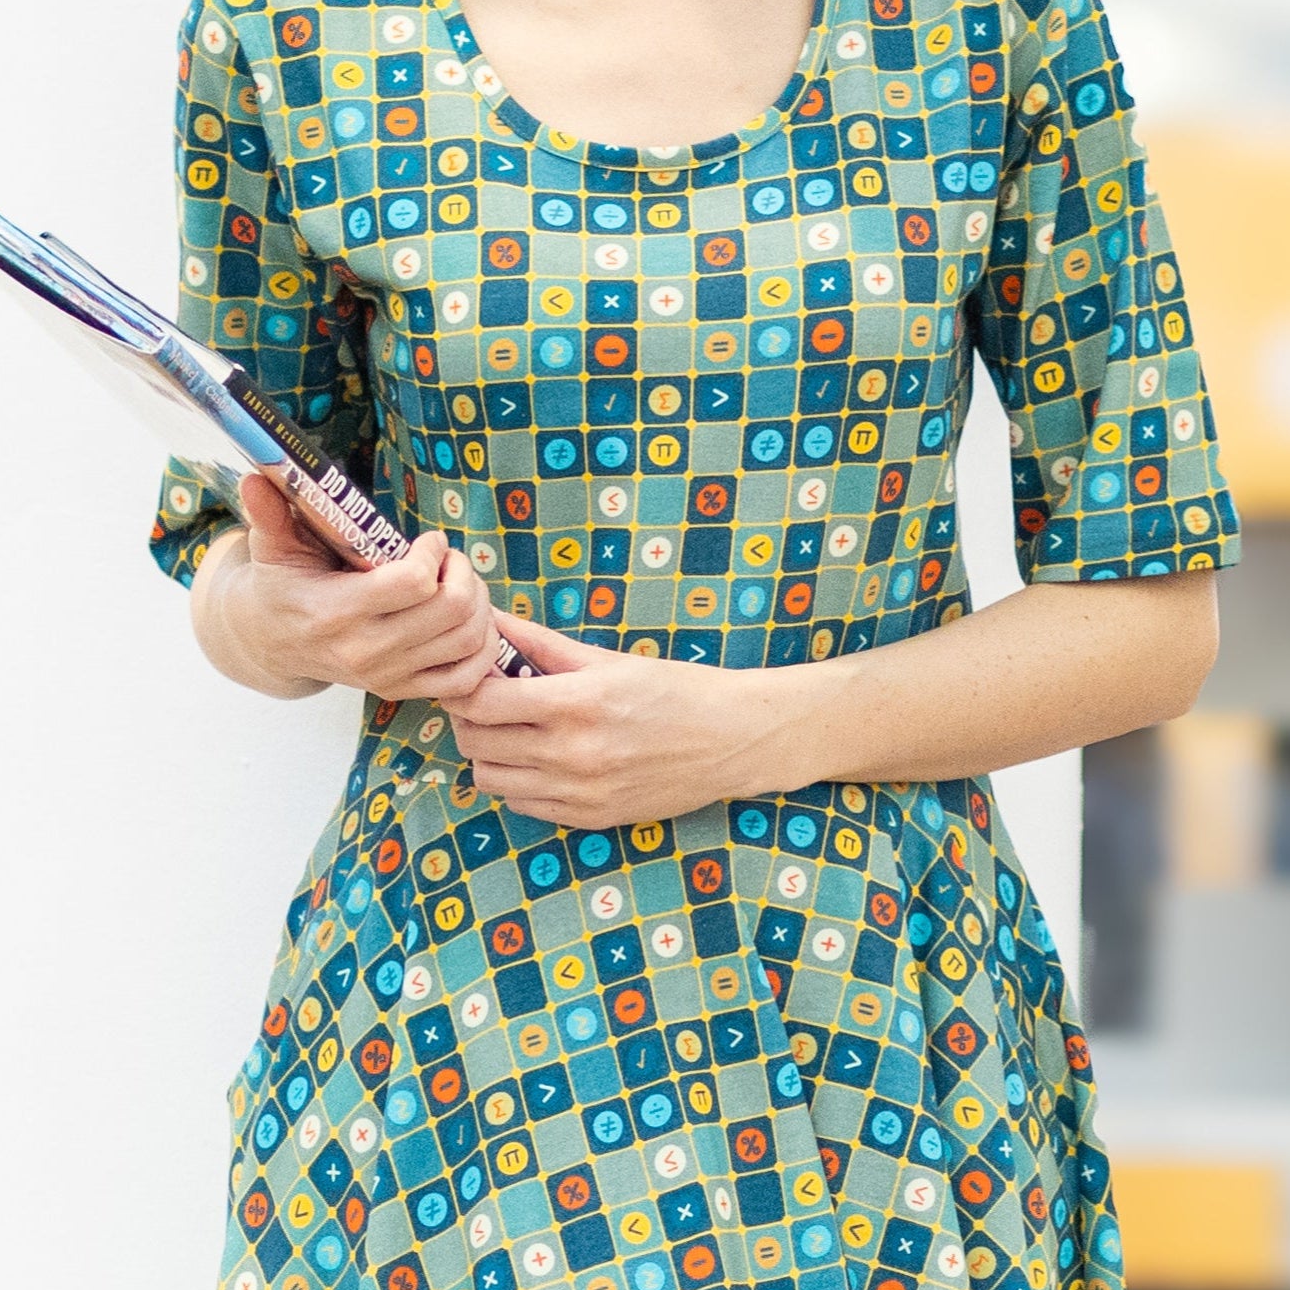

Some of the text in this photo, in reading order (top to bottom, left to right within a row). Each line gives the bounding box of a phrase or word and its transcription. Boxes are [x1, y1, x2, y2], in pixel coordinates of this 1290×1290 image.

[241, 390, 320, 469] DANICA McKELLAR
[281, 458, 390, 568] TYRANNOSAU
[318, 465, 347, 498] DO
[339, 486, 377, 526] NOT
[366, 515, 410, 561] OPEN
